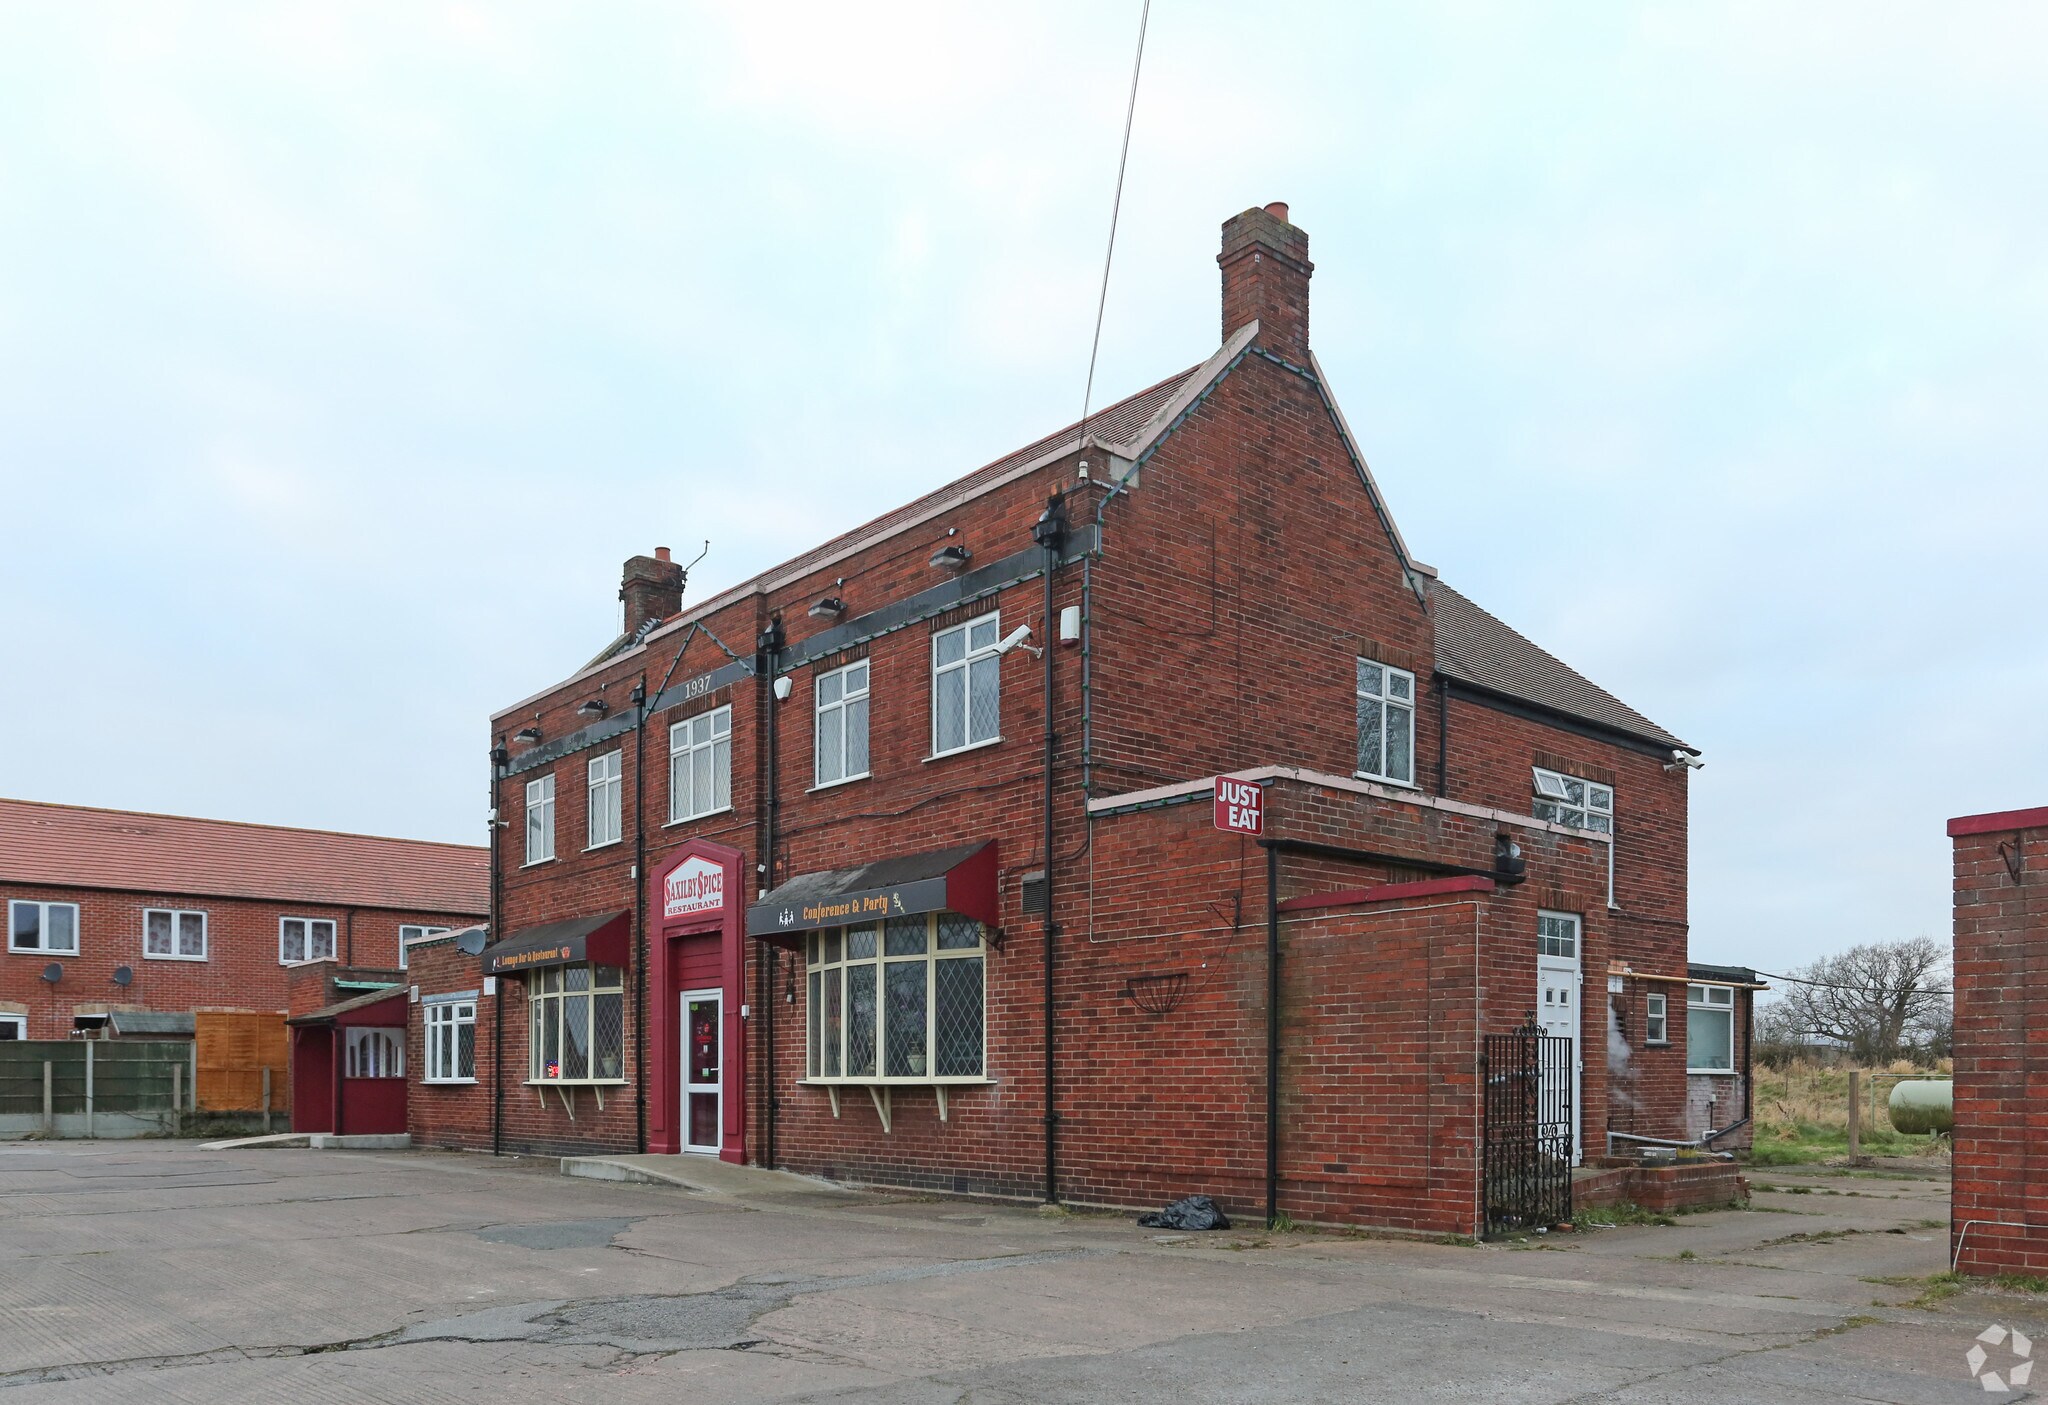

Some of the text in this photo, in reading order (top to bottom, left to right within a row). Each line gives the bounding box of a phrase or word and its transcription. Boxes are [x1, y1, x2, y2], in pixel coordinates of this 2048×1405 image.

[685, 675, 711, 698] 1937
[1218, 781, 1259, 808] JUST
[1229, 806, 1259, 830] EAT
[665, 871, 722, 906] SAXILBY SPICE
[668, 899, 720, 914] RESTAURANT
[803, 895, 888, 924] Conference & Party
[502, 955, 518, 968] Lounge
[519, 953, 527, 963] Bar
[532, 947, 558, 962] Restaurant
